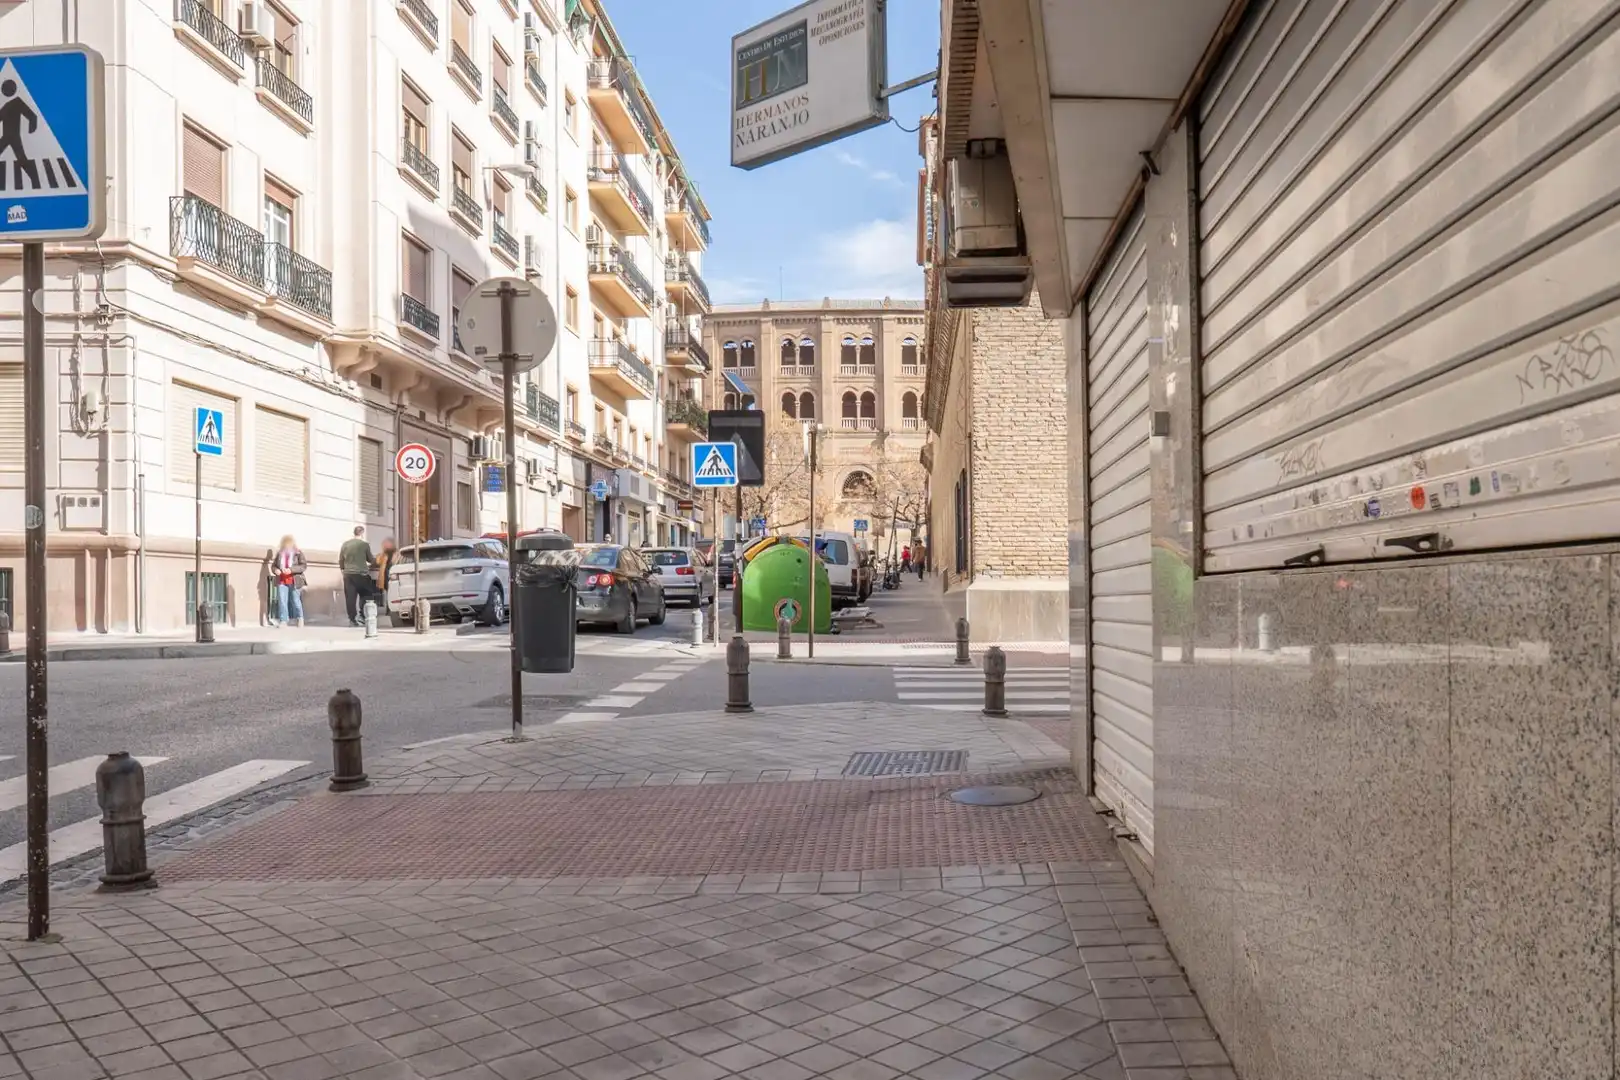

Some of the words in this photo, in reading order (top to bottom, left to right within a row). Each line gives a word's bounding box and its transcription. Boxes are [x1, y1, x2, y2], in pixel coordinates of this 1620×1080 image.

[738, 45, 763, 61] CENTRO
[773, 28, 805, 46] ESTUDIOS
[818, 20, 865, 46] OPOSICIONES
[736, 91, 809, 130] HERMANOS
[736, 109, 809, 148] NARANJO
[405, 456, 426, 470] 20
